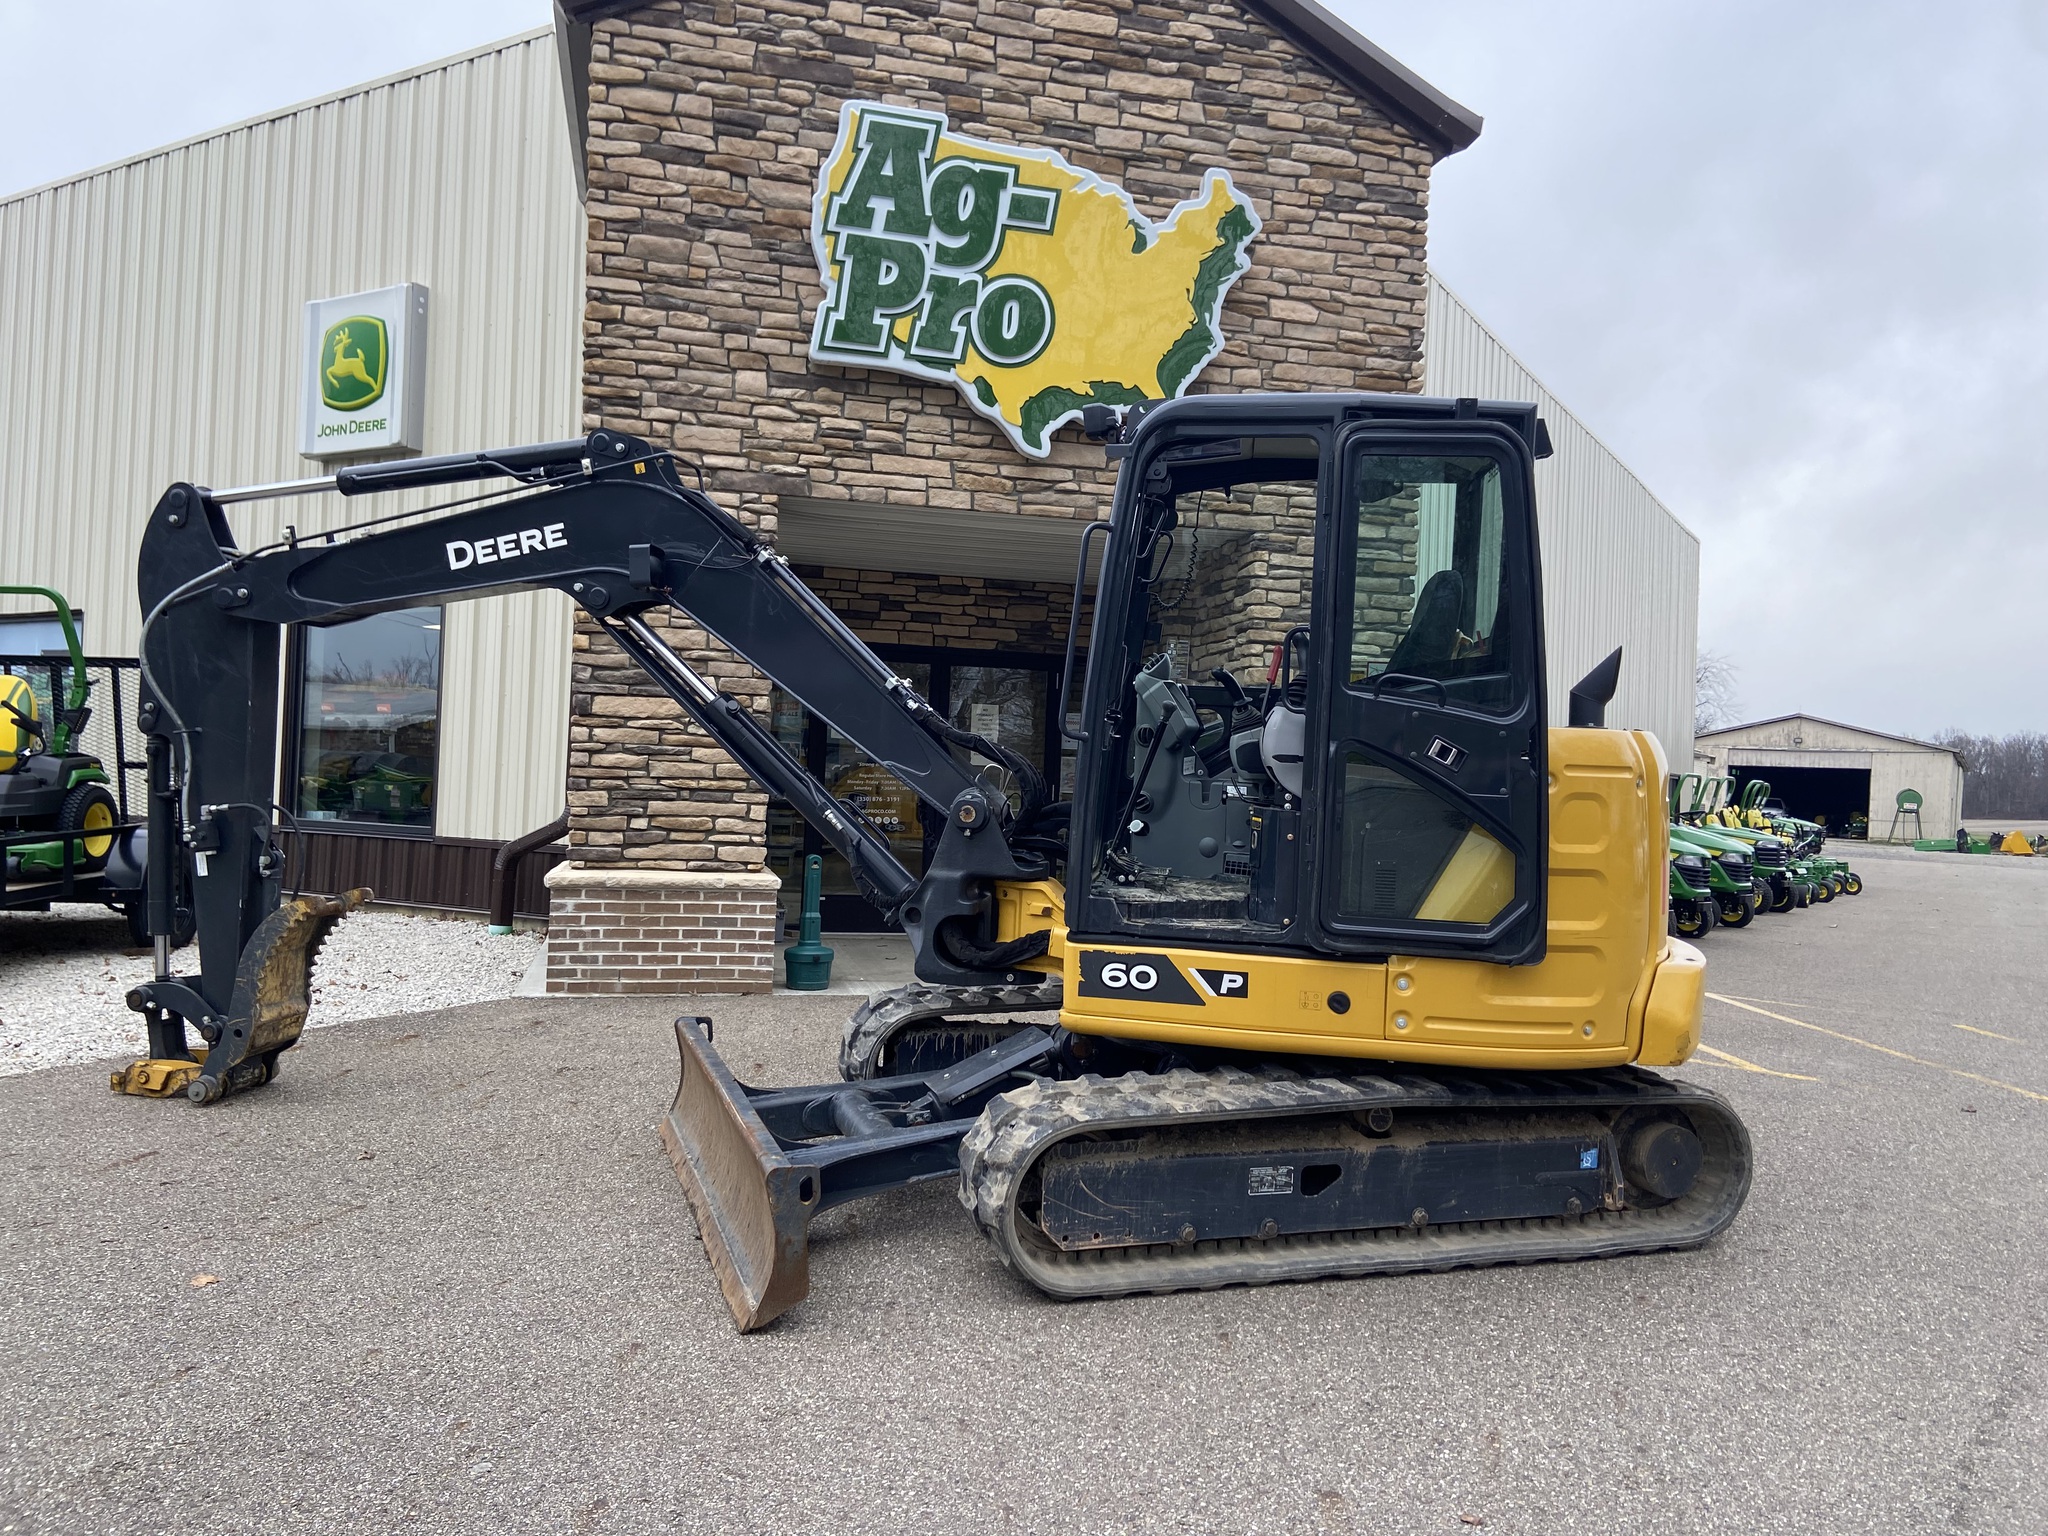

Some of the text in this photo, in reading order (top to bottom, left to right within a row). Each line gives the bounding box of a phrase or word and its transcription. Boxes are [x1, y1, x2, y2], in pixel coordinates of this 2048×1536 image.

[827, 114, 1058, 271] Ag-
[825, 233, 1051, 363] Pro
[317, 418, 387, 438] JOHN DEERE
[446, 522, 568, 570] DEERE
[1101, 962, 1244, 994] 60 P
